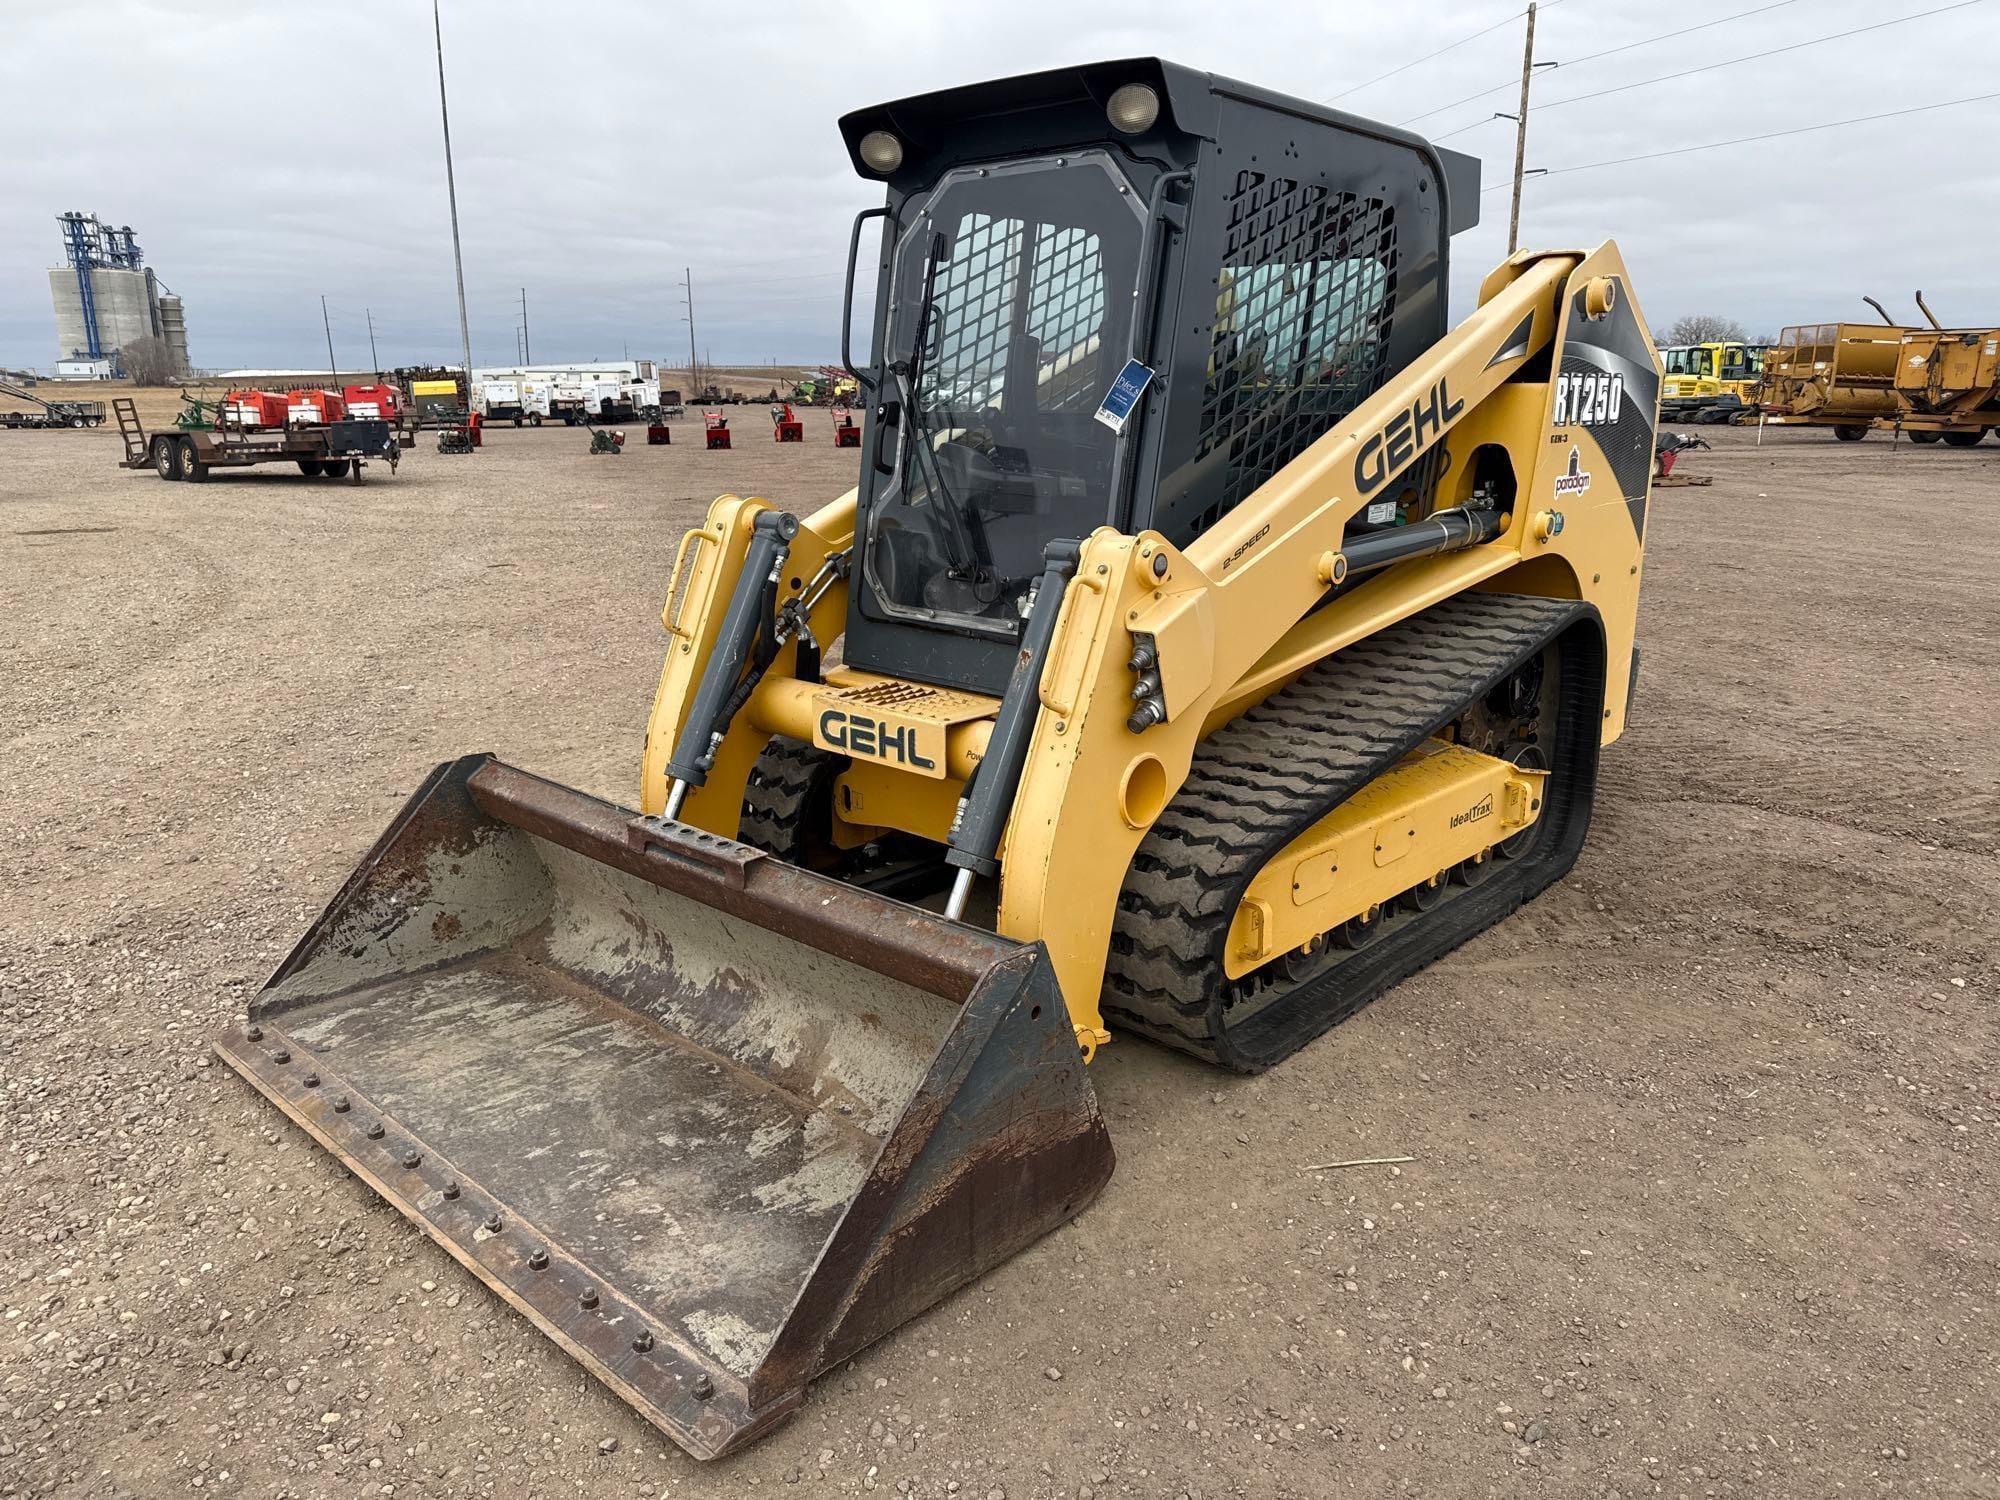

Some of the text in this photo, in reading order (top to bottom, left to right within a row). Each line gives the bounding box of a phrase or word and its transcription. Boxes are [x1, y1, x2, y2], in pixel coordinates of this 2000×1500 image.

[1552, 372, 1623, 427] RT250
[1355, 376, 1464, 493] GEHL
[1555, 474, 1590, 497] paradigm
[1222, 523, 1271, 570] 2-SPEED
[820, 709, 936, 770] GEHL
[966, 750, 984, 761] Pow
[1449, 801, 1492, 830] IdealTrax
